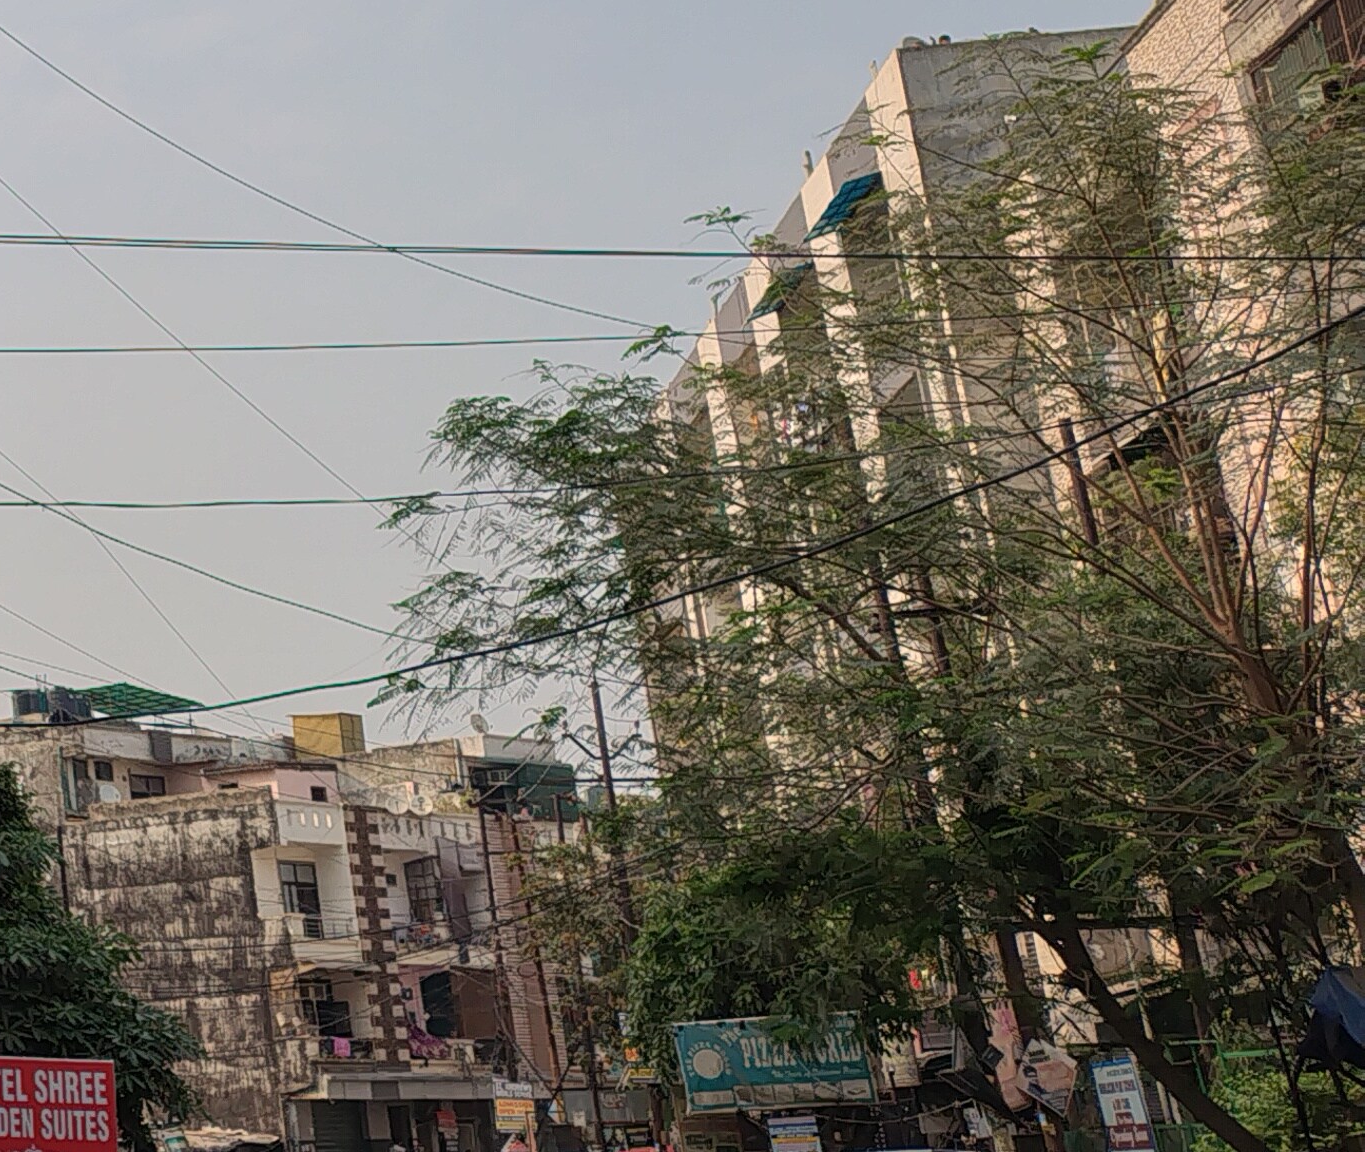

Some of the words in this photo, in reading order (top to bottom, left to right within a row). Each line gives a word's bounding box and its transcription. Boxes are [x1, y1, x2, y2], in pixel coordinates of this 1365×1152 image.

[738, 1036, 798, 1069] PIZZA
[34, 1068, 109, 1106] SHREE
[39, 1108, 110, 1142] SUITES
